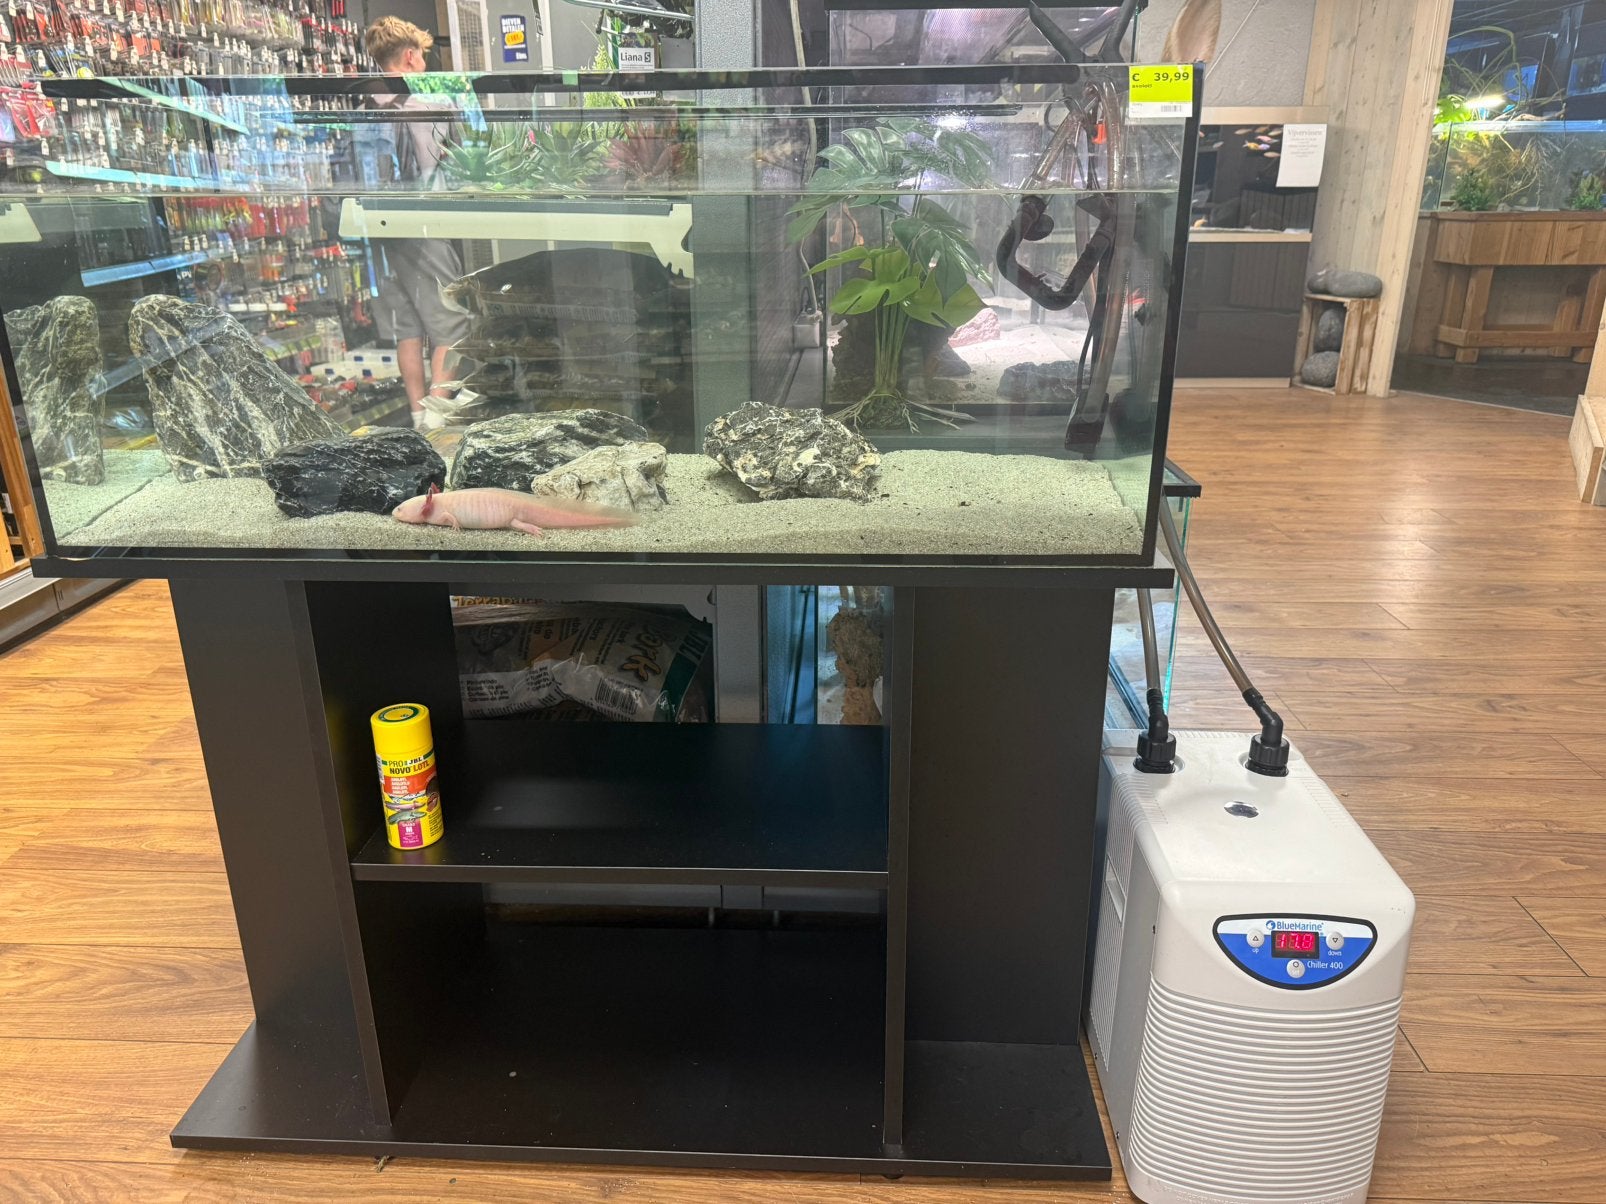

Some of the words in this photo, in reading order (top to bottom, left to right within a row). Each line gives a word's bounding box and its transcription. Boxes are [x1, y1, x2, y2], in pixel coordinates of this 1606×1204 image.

[620, 52, 643, 61] Liana
[644, 51, 651, 62] S
[1153, 71, 1190, 83] 39,99
[388, 759, 404, 768] PRO
[409, 757, 424, 765] JBL
[389, 766, 412, 775] NOVO
[413, 760, 430, 773] LOTL
[1276, 922, 1322, 931] BlueMarine
[1307, 960, 1329, 970] Chiller
[1330, 961, 1344, 970] 400
